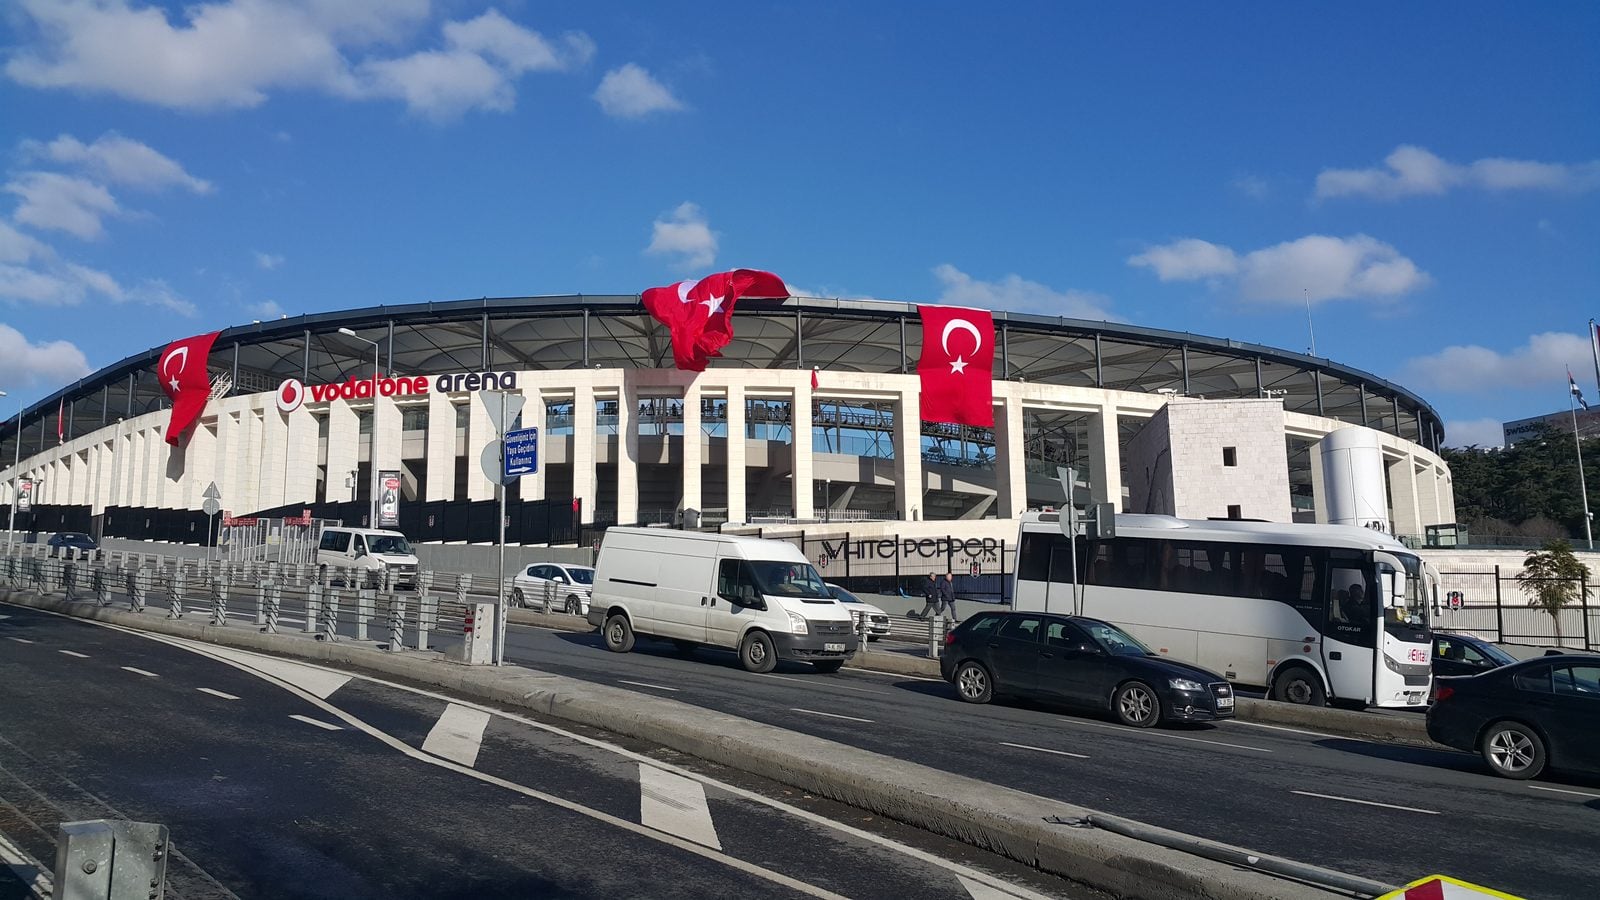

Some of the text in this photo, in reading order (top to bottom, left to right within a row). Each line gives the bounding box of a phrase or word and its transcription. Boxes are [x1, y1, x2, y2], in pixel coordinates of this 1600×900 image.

[311, 371, 517, 402] vodafone arena
[507, 446, 517, 457] Yaya
[1337, 625, 1361, 633] OTOKAR
